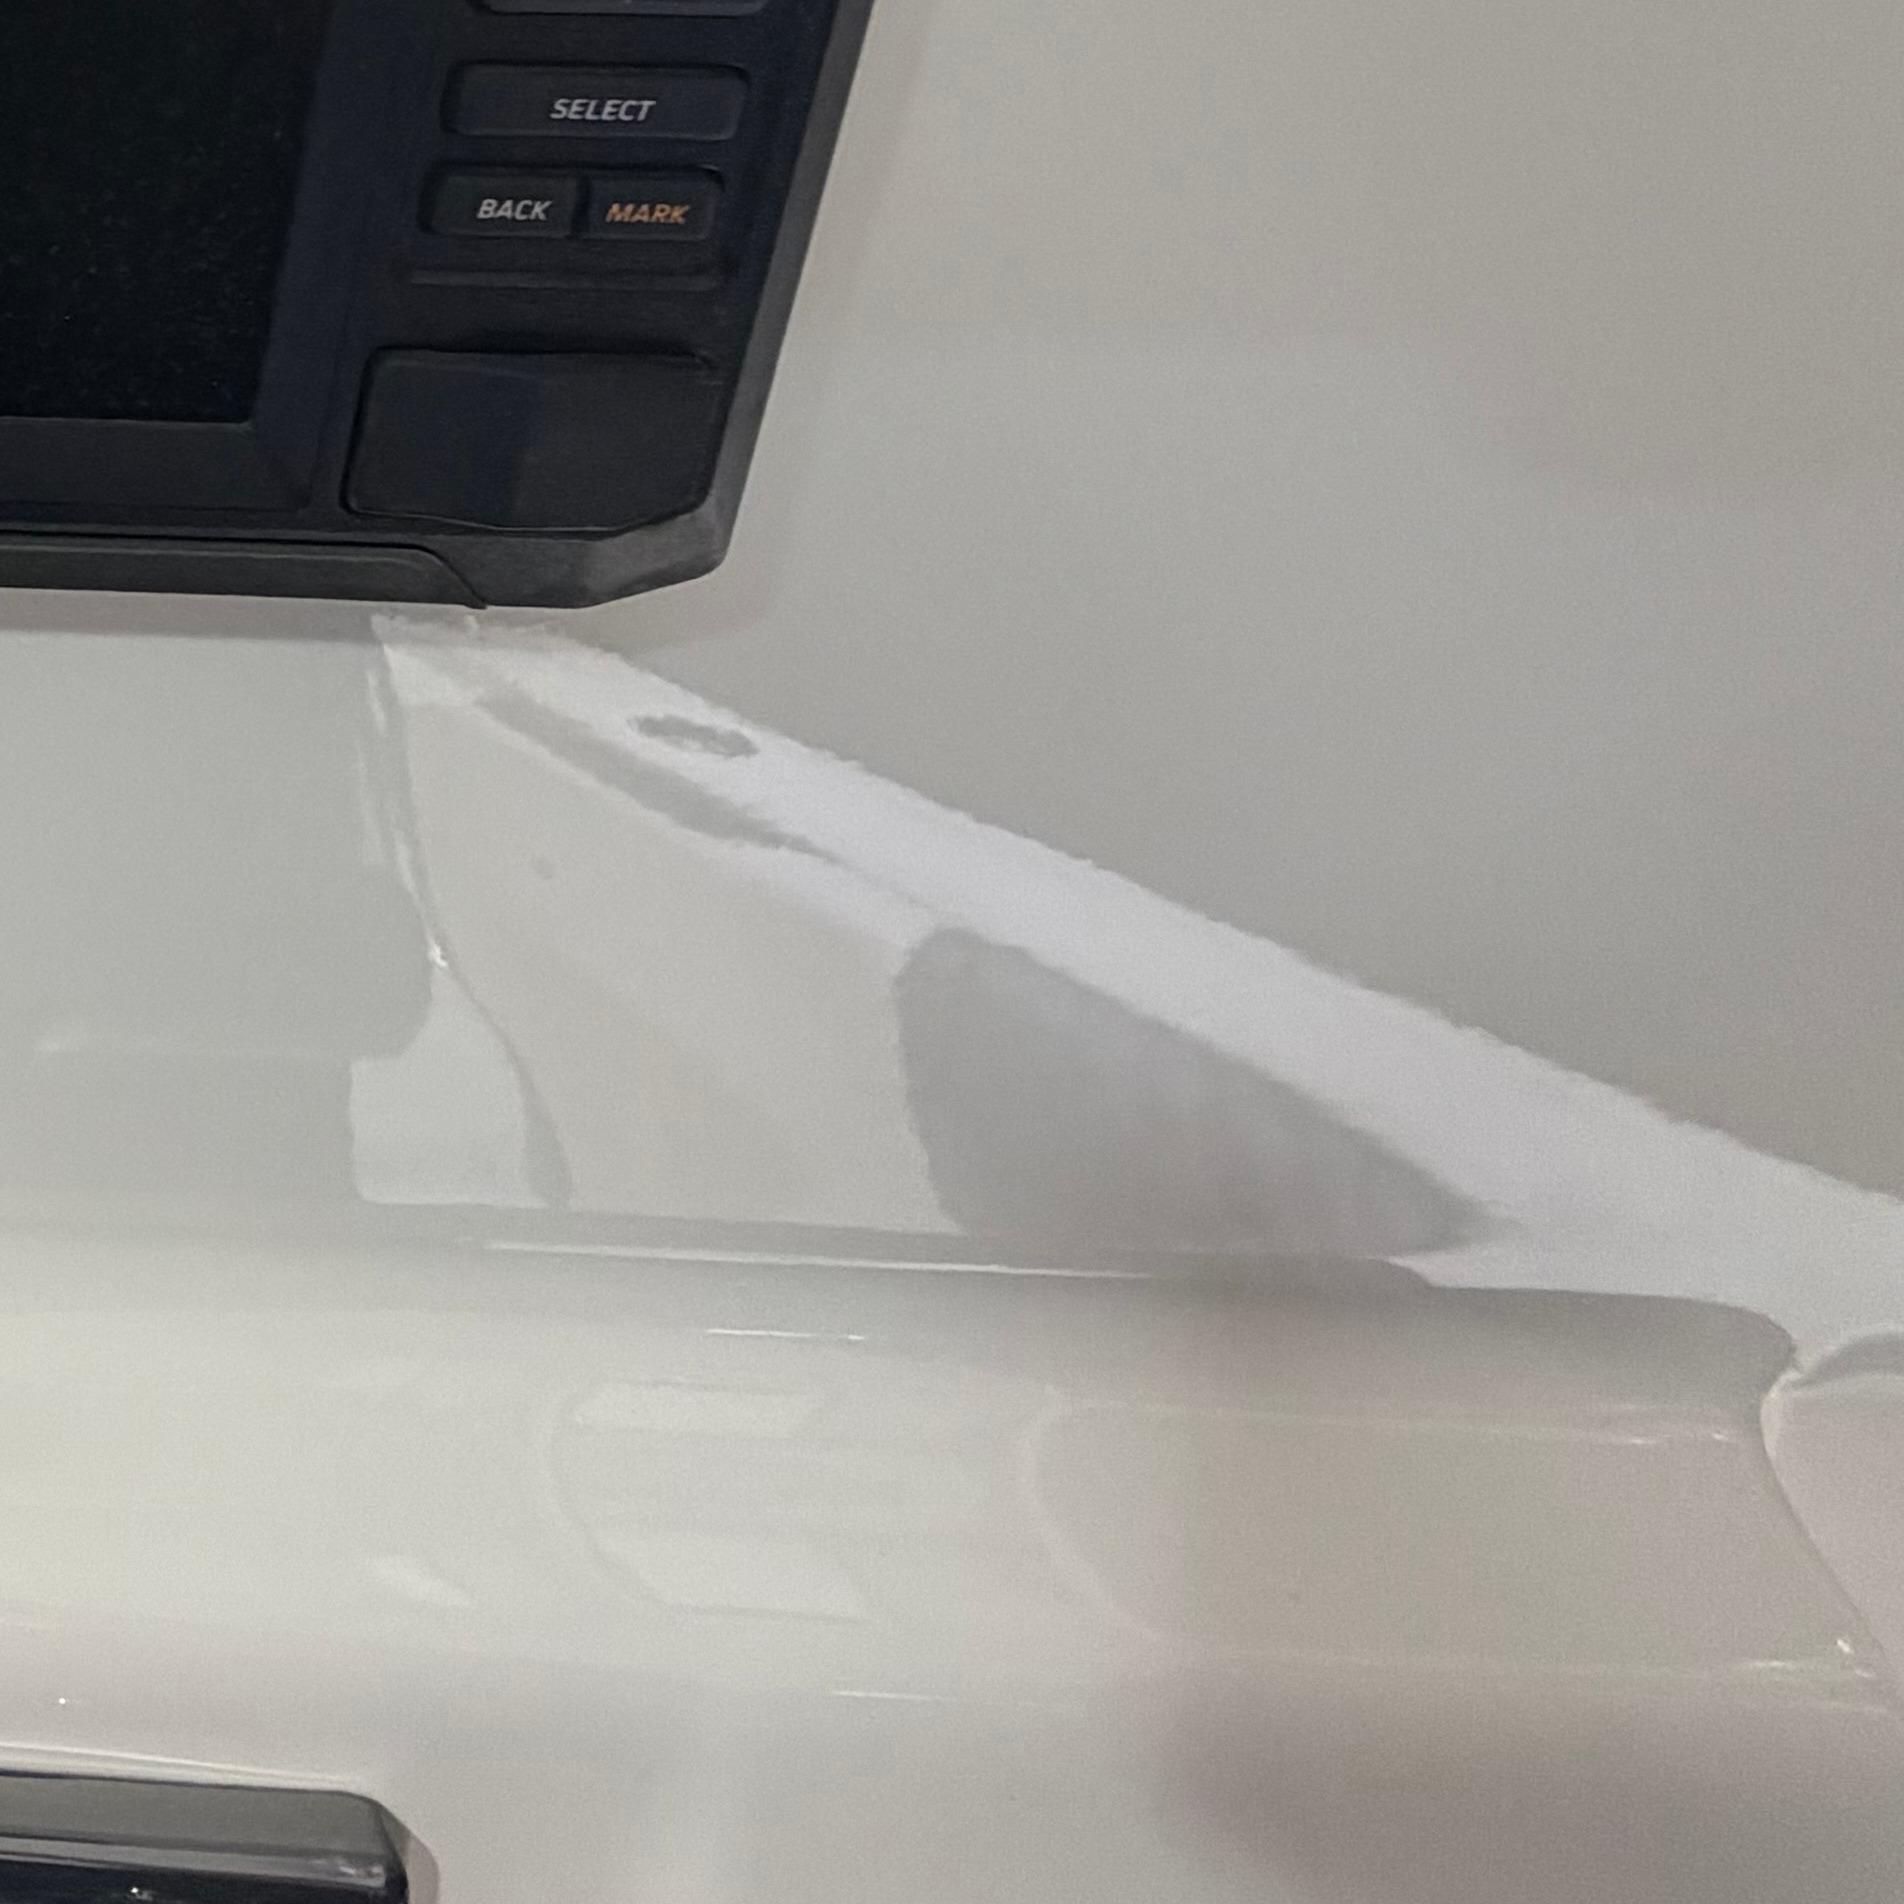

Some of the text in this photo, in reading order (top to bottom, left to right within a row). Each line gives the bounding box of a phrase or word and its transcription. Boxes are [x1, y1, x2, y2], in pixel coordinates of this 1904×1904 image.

[549, 98, 657, 122] SELECT
[476, 198, 553, 221] BACK
[605, 202, 690, 225] MARK
